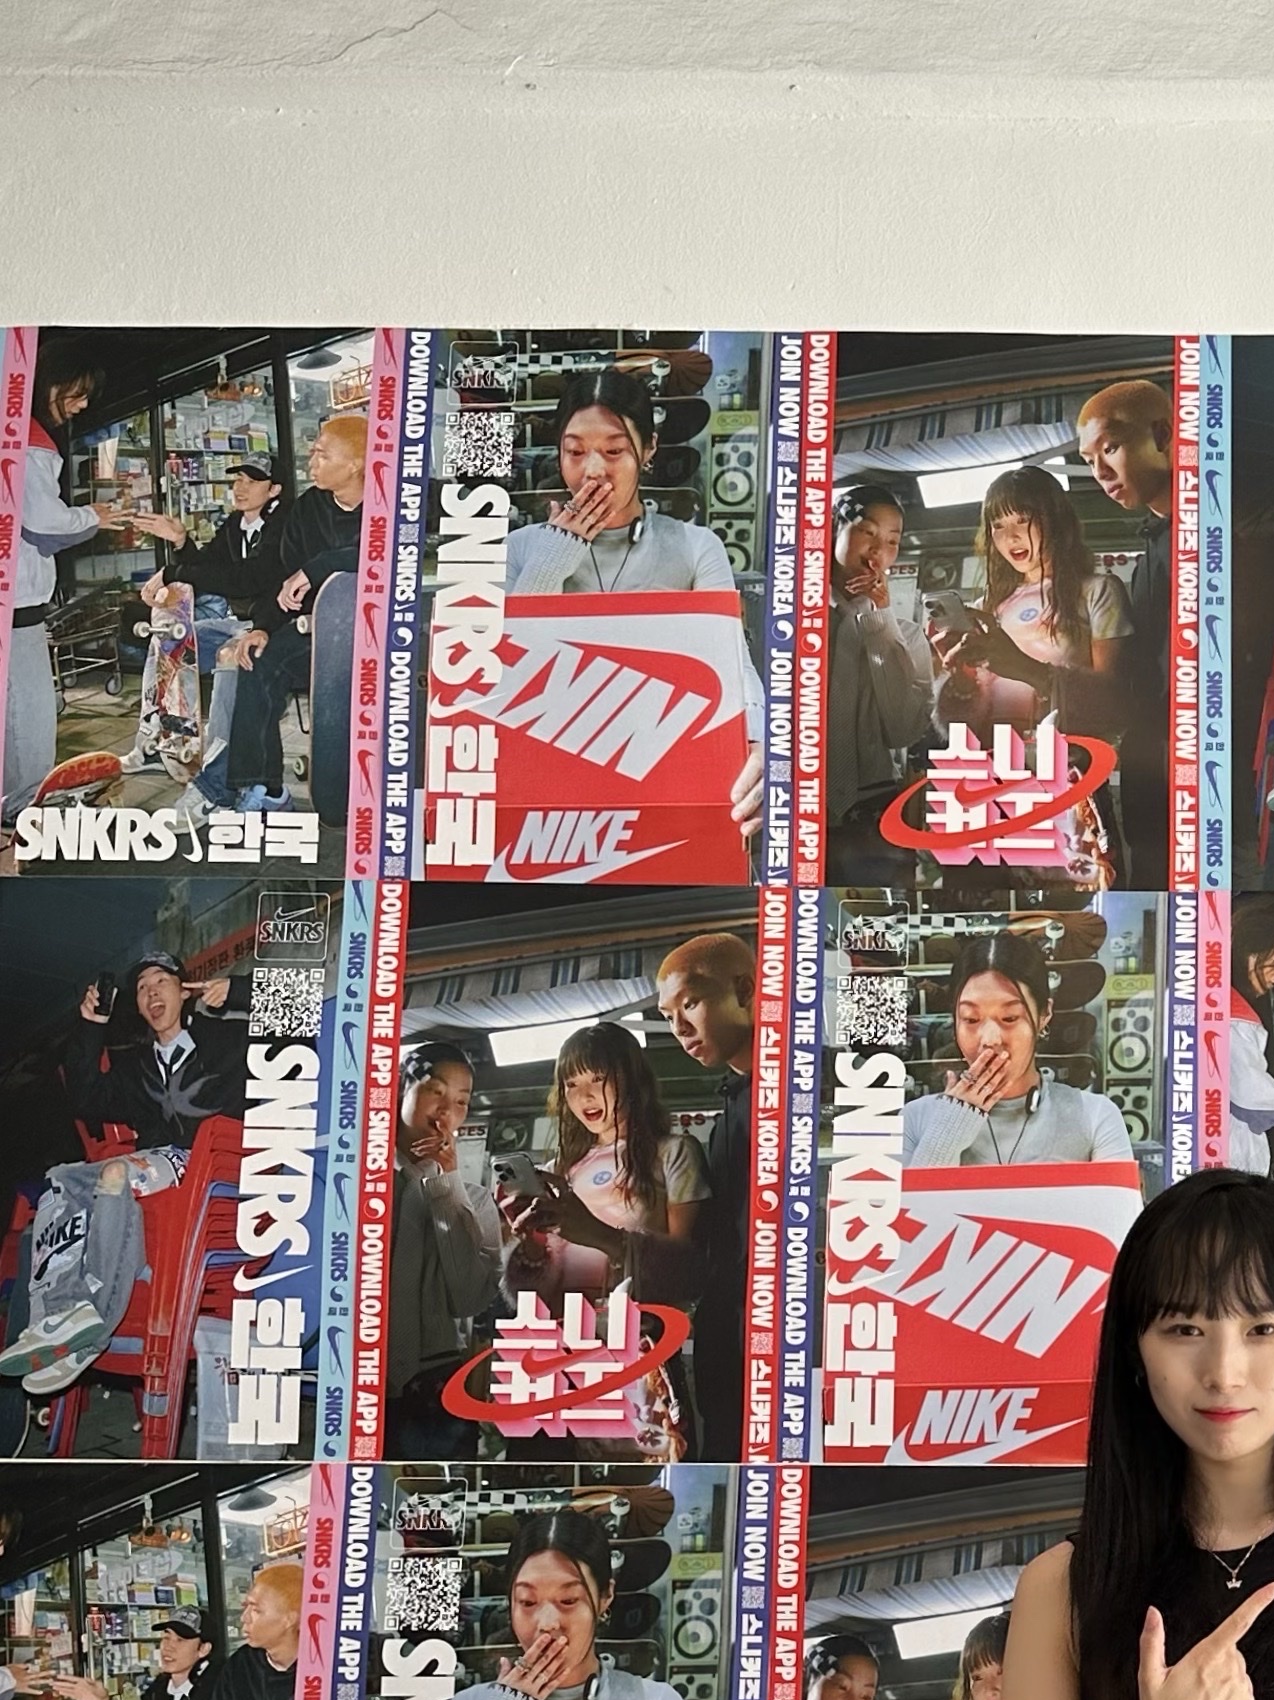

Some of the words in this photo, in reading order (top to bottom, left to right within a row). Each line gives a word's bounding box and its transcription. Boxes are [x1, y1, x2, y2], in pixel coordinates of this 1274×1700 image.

[405, 332, 431, 438] DOWNLOAD
[1180, 340, 1198, 385] JOIN
[378, 376, 394, 420] SNKRS
[1179, 392, 1198, 441] NOW
[403, 444, 424, 477] THE
[401, 483, 421, 521] APP
[368, 517, 386, 561] SNKRS
[395, 546, 418, 601] SNKRS
[431, 484, 511, 688] SNKRS
[1178, 562, 1197, 624] KOREA
[360, 659, 377, 706] SNKRS
[1176, 657, 1197, 703] JOIN
[388, 652, 411, 766] DOWNLOAD
[1176, 710, 1196, 760] NOW
[387, 772, 407, 807] THE
[427, 724, 499, 867] 한국
[14, 808, 184, 862] SNKRS
[206, 812, 320, 863] 한국
[355, 808, 372, 855] SNKRS
[385, 813, 406, 853] APP
[512, 810, 640, 865] NIKE
[1176, 896, 1196, 943] JOIN
[347, 932, 366, 979] SNKRS
[796, 890, 819, 1003] DOWNLOAD
[1206, 941, 1222, 988] SNKRS
[1175, 950, 1195, 1000] NOW
[795, 1009, 815, 1044] THE
[794, 1050, 814, 1090] APP
[339, 1081, 357, 1129] SNKRS
[236, 1044, 320, 1257] SNKRS
[791, 1116, 813, 1174] SNKRS
[829, 1052, 906, 1262] SNKRS
[331, 1232, 348, 1281] SNKRS
[786, 1228, 808, 1344] DOWNLOAD
[228, 1298, 306, 1446] 한국
[785, 1351, 805, 1386] THE
[824, 1302, 897, 1448] 한국
[325, 1387, 343, 1436] SNKRS
[783, 1393, 804, 1435] APP
[910, 1388, 1039, 1446] NIKE
[746, 1470, 769, 1519] JOIN
[743, 1527, 766, 1581] NOW
